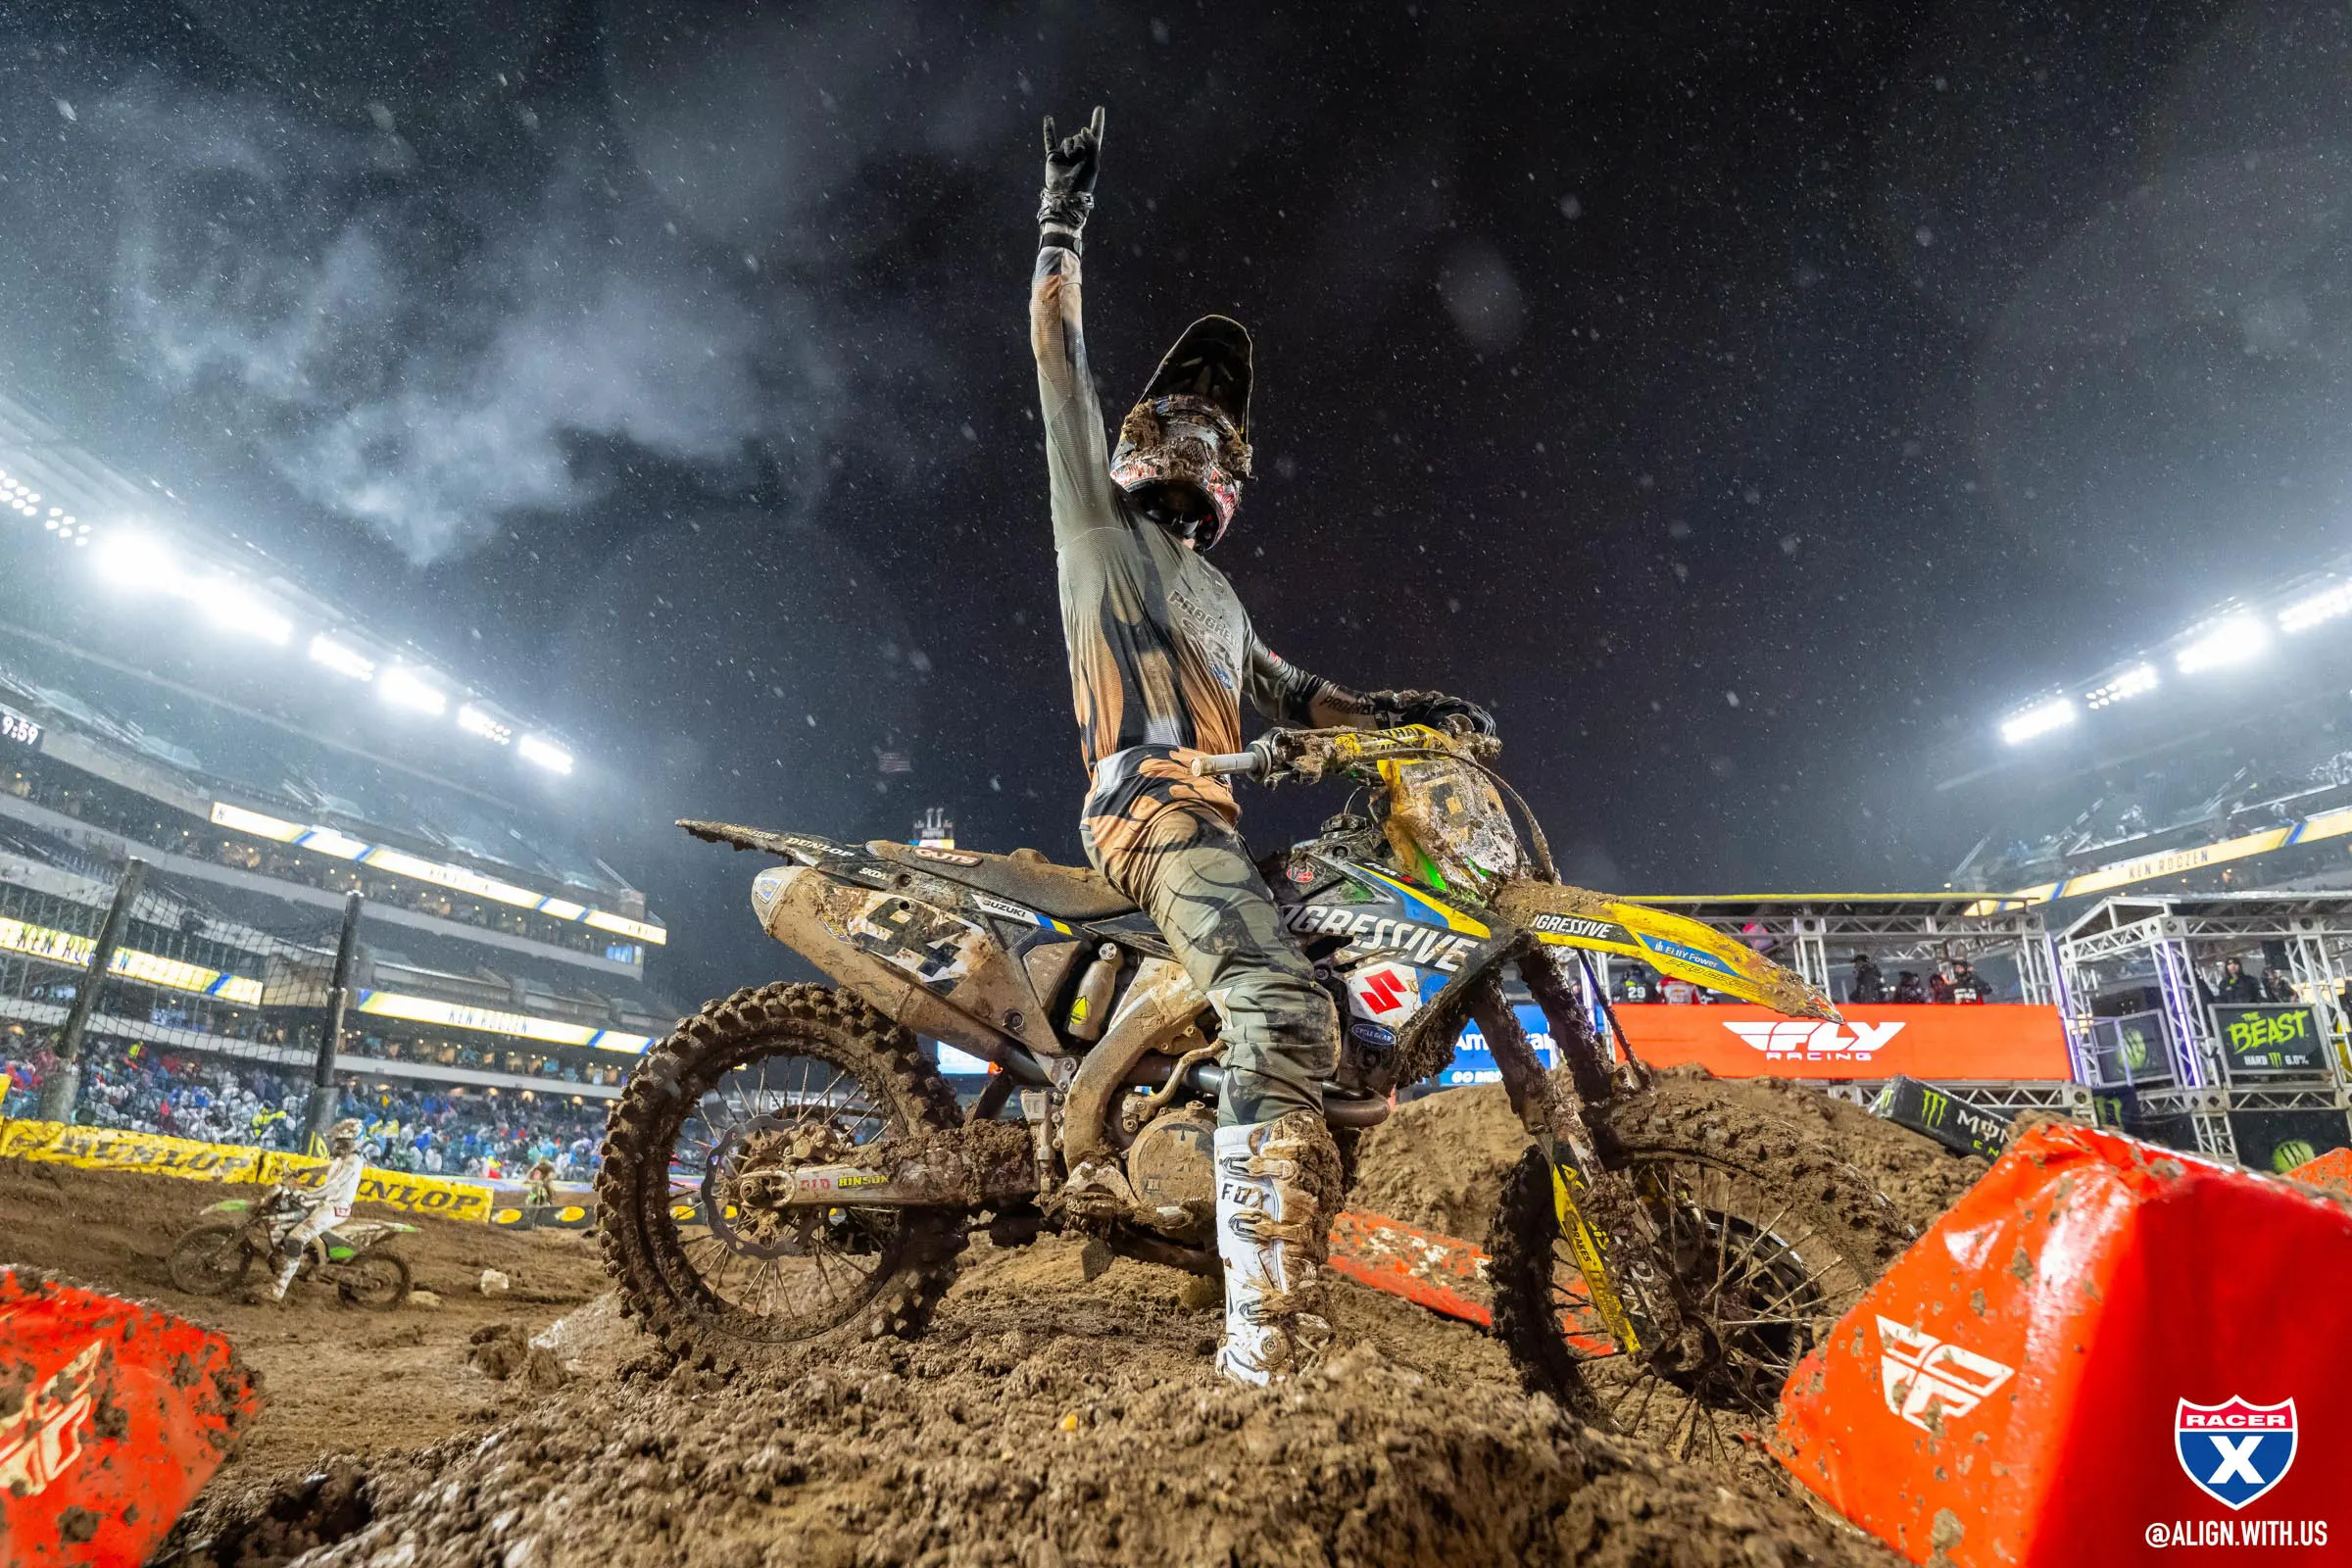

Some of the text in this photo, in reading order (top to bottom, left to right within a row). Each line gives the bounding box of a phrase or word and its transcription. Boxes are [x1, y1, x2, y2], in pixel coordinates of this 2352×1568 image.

[2, 715, 39, 745] 9:59
[784, 837, 856, 858] DUNLOP
[913, 848, 980, 864] GUTS
[2129, 864, 2153, 880] KEN
[982, 899, 1028, 918] SUZUKI
[1690, 951, 1718, 968] Power
[1628, 986, 1646, 999] 29
[1722, 1021, 1907, 1051] FLY
[2226, 1009, 2310, 1054] BEAST
[1766, 1052, 1872, 1060] RACING
[2244, 1054, 2269, 1066] HARD
[838, 1175, 889, 1190] HINSON
[1221, 1182, 1271, 1210] FOX
